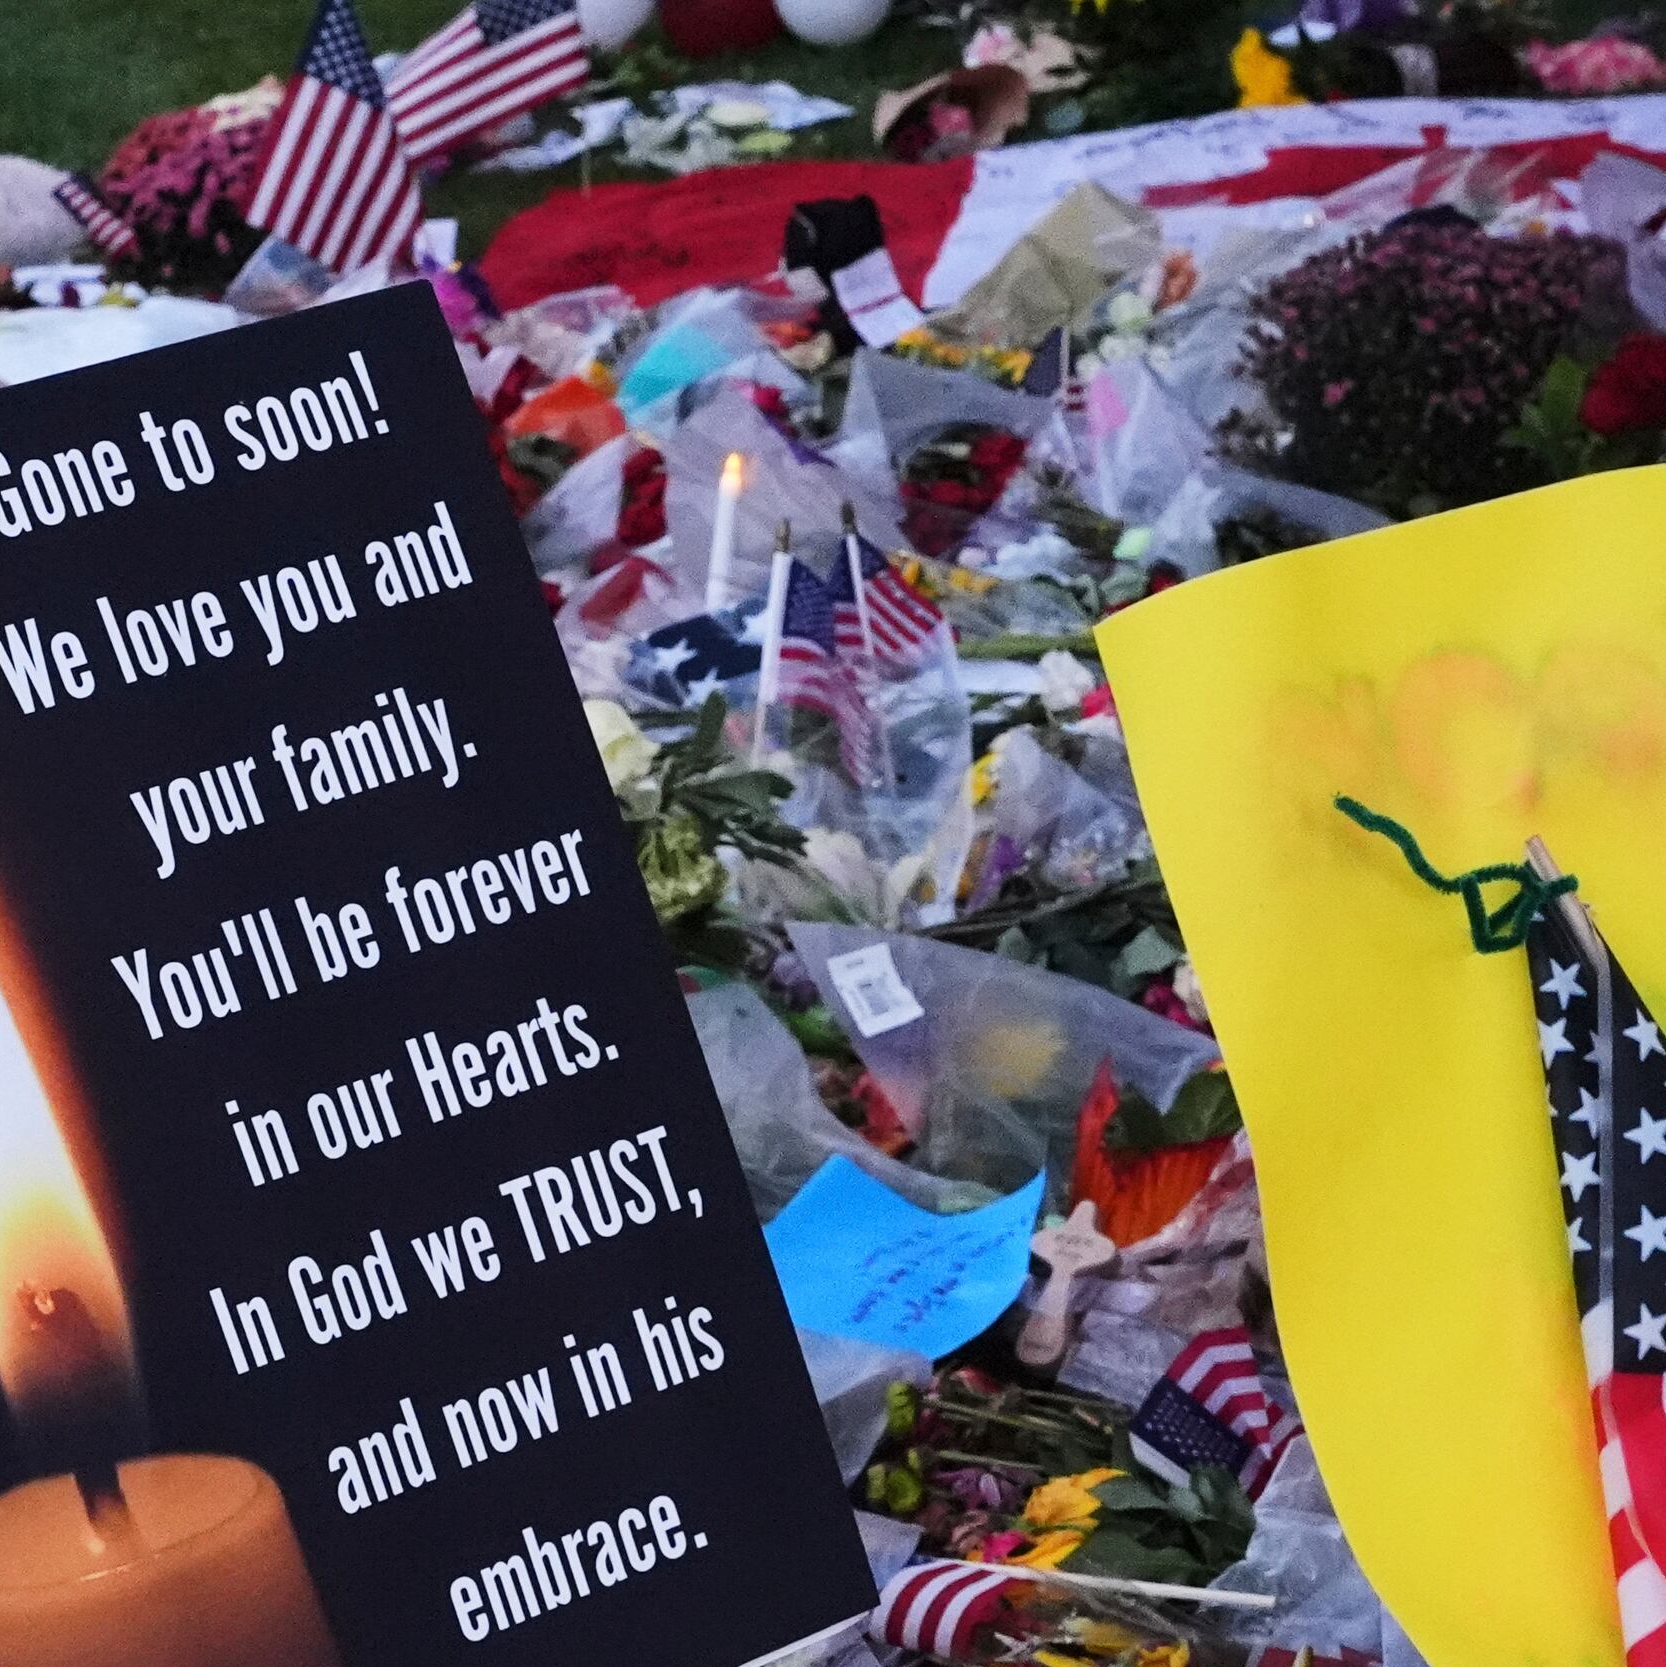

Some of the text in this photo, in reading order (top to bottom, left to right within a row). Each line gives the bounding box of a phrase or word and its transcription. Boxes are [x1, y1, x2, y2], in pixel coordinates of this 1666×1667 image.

[140, 412, 214, 491] to
[224, 351, 389, 470] soon!
[96, 592, 233, 683] love
[240, 555, 356, 665] you
[365, 501, 472, 606] and
[130, 688, 477, 879] your family.
[111, 829, 590, 1039] You'll be forever
[225, 998, 618, 1186] in our Hearts.
[210, 1126, 702, 1374] In God we TRUST,
[329, 1307, 724, 1513] and now in his
[450, 1496, 708, 1641] embrace.
